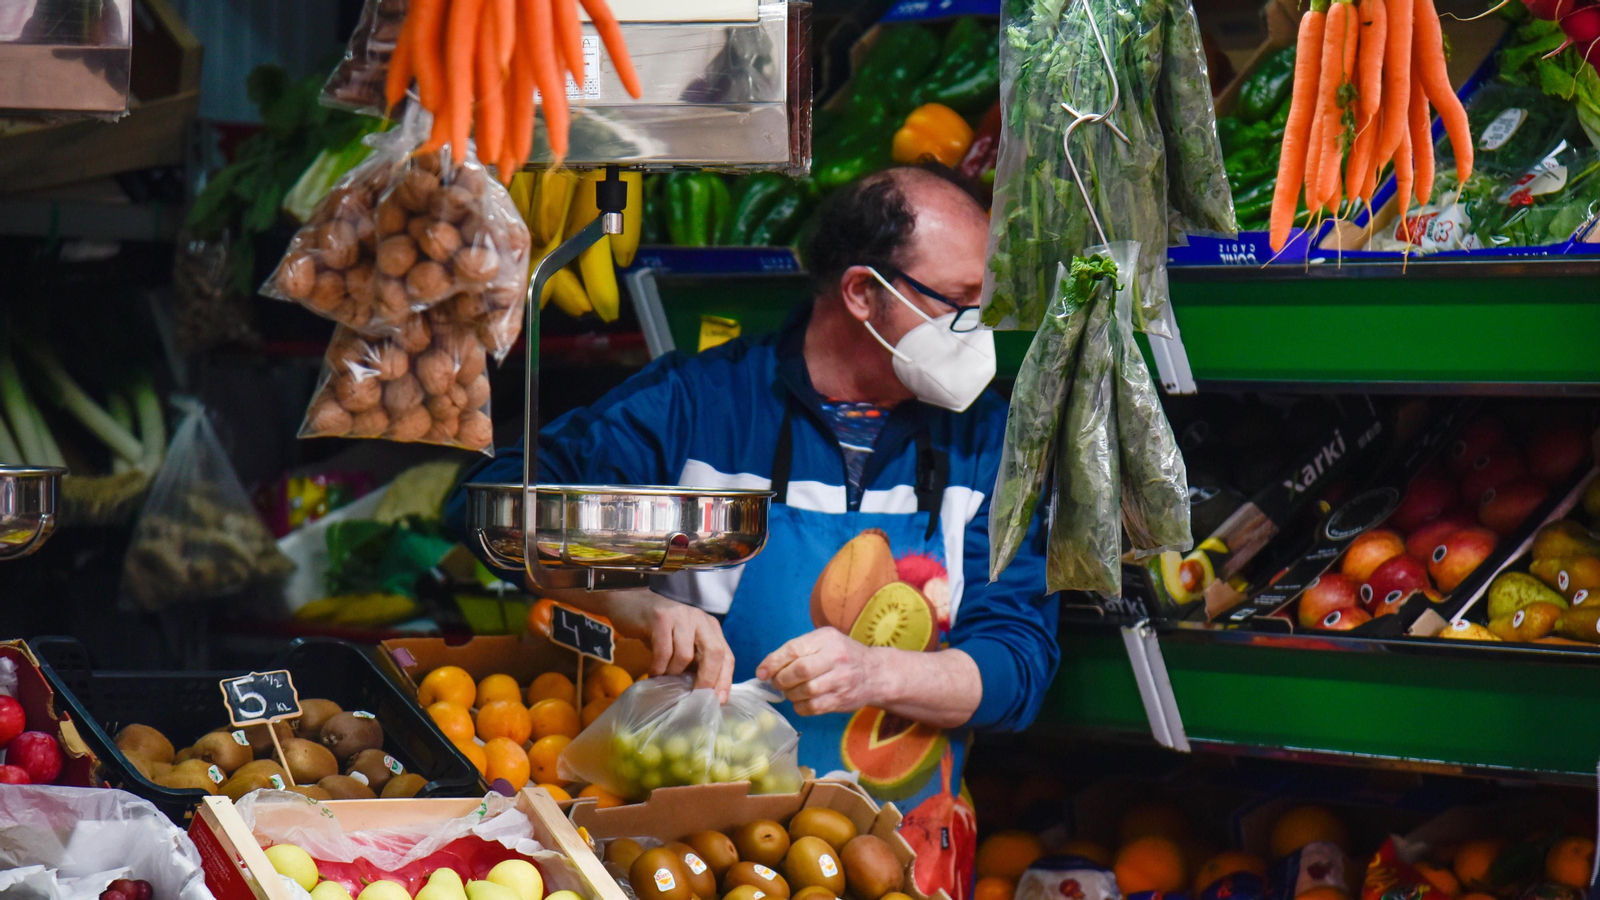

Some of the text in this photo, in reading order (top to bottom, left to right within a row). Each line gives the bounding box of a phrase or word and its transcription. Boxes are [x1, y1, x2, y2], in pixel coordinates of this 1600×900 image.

[1219, 243, 1256, 253] CADIZ
[562, 611, 581, 647] 4
[232, 676, 267, 718] 5
[275, 702, 292, 712] KL
